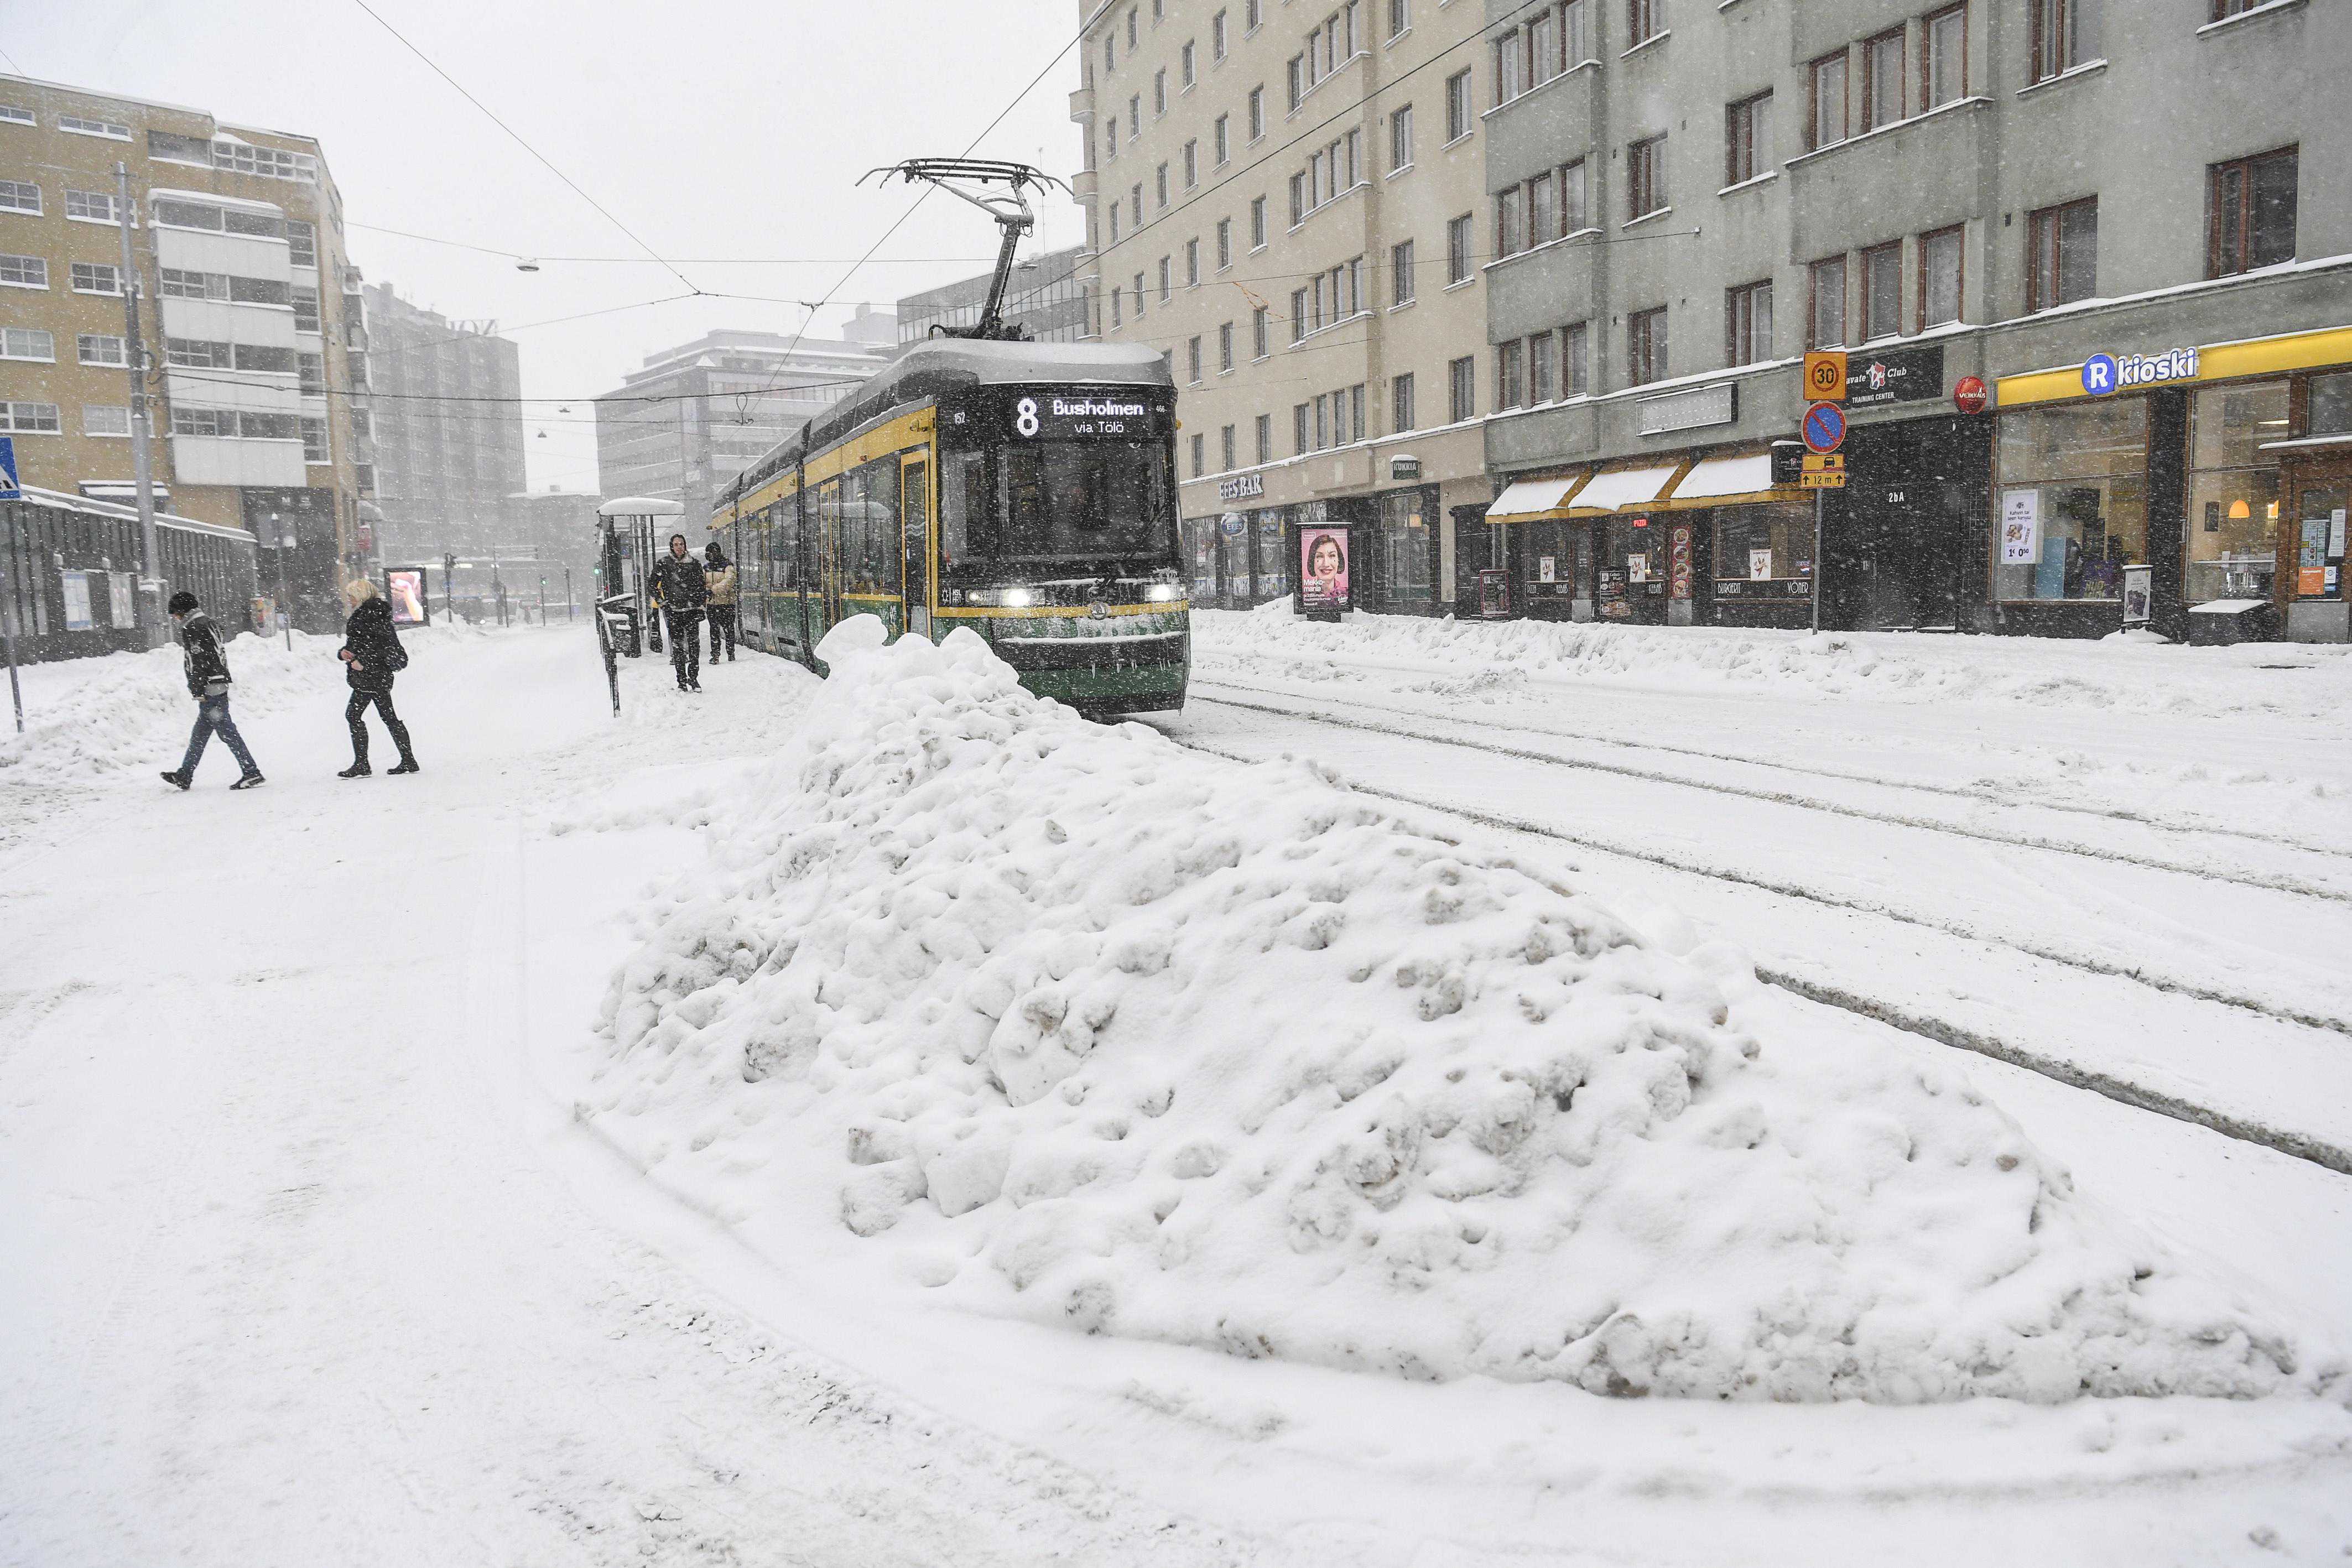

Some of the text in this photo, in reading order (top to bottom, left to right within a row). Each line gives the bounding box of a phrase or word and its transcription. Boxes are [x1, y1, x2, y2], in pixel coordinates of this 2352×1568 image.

[2089, 347, 2195, 389] R kioski
[1817, 368, 1834, 384] 30
[1846, 366, 1907, 384] avate Club
[1852, 391, 1895, 404] TRAINING CENTER
[1053, 400, 1144, 415] Busholmen
[1017, 397, 1039, 436] 8
[1074, 421, 1124, 433] via Tölö
[1393, 462, 1417, 471] KUKKIA
[1814, 476, 1822, 484] 12
[1219, 474, 1263, 500] EFES BAR
[1888, 492, 1905, 502] 2bA
[1633, 518, 1648, 527] PIZZA
[1718, 582, 1741, 593] BURGERIT
[1787, 581, 1809, 593] VÖNER
